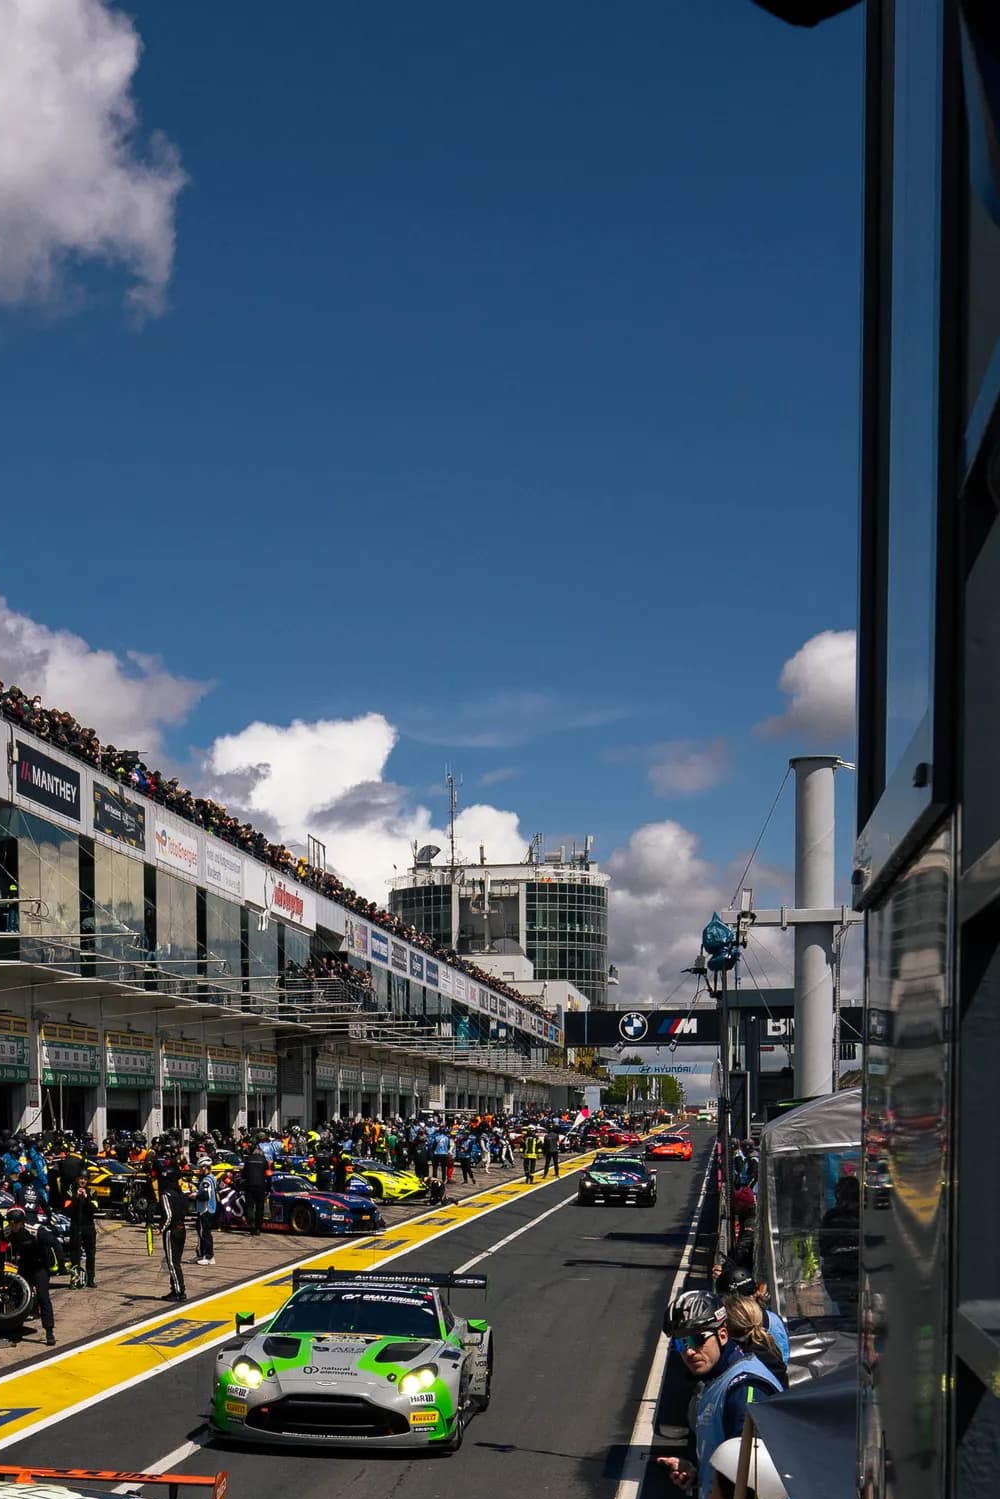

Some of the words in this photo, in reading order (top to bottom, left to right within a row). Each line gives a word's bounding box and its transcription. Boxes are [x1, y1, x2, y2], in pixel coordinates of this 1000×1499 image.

[32, 764, 77, 805] MANTHEY
[388, 1295, 423, 1304] TURISMO
[227, 1385, 240, 1396] H&R
[410, 1394, 426, 1403] H&R
[411, 1413, 437, 1423] PIRELLI
